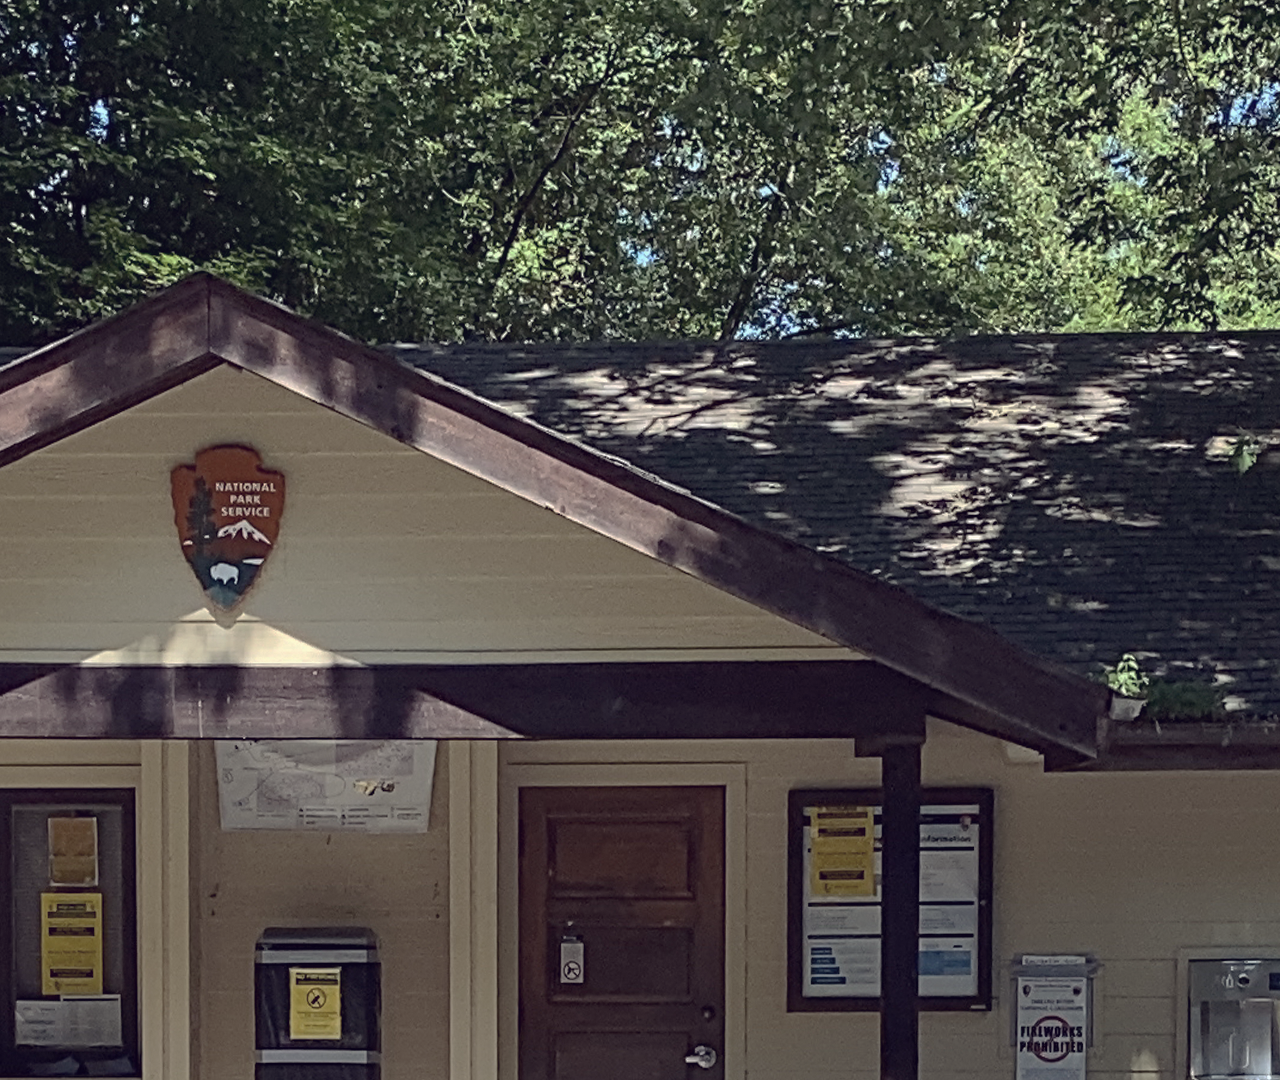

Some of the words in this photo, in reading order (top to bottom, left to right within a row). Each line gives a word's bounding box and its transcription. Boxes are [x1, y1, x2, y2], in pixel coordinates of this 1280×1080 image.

[215, 482, 276, 492] NATIONAL
[229, 495, 261, 504] PARK
[221, 507, 270, 516] SERVICE
[1020, 1026, 1083, 1038] FIREWORKS
[1019, 1041, 1084, 1053] PROHIBITED
